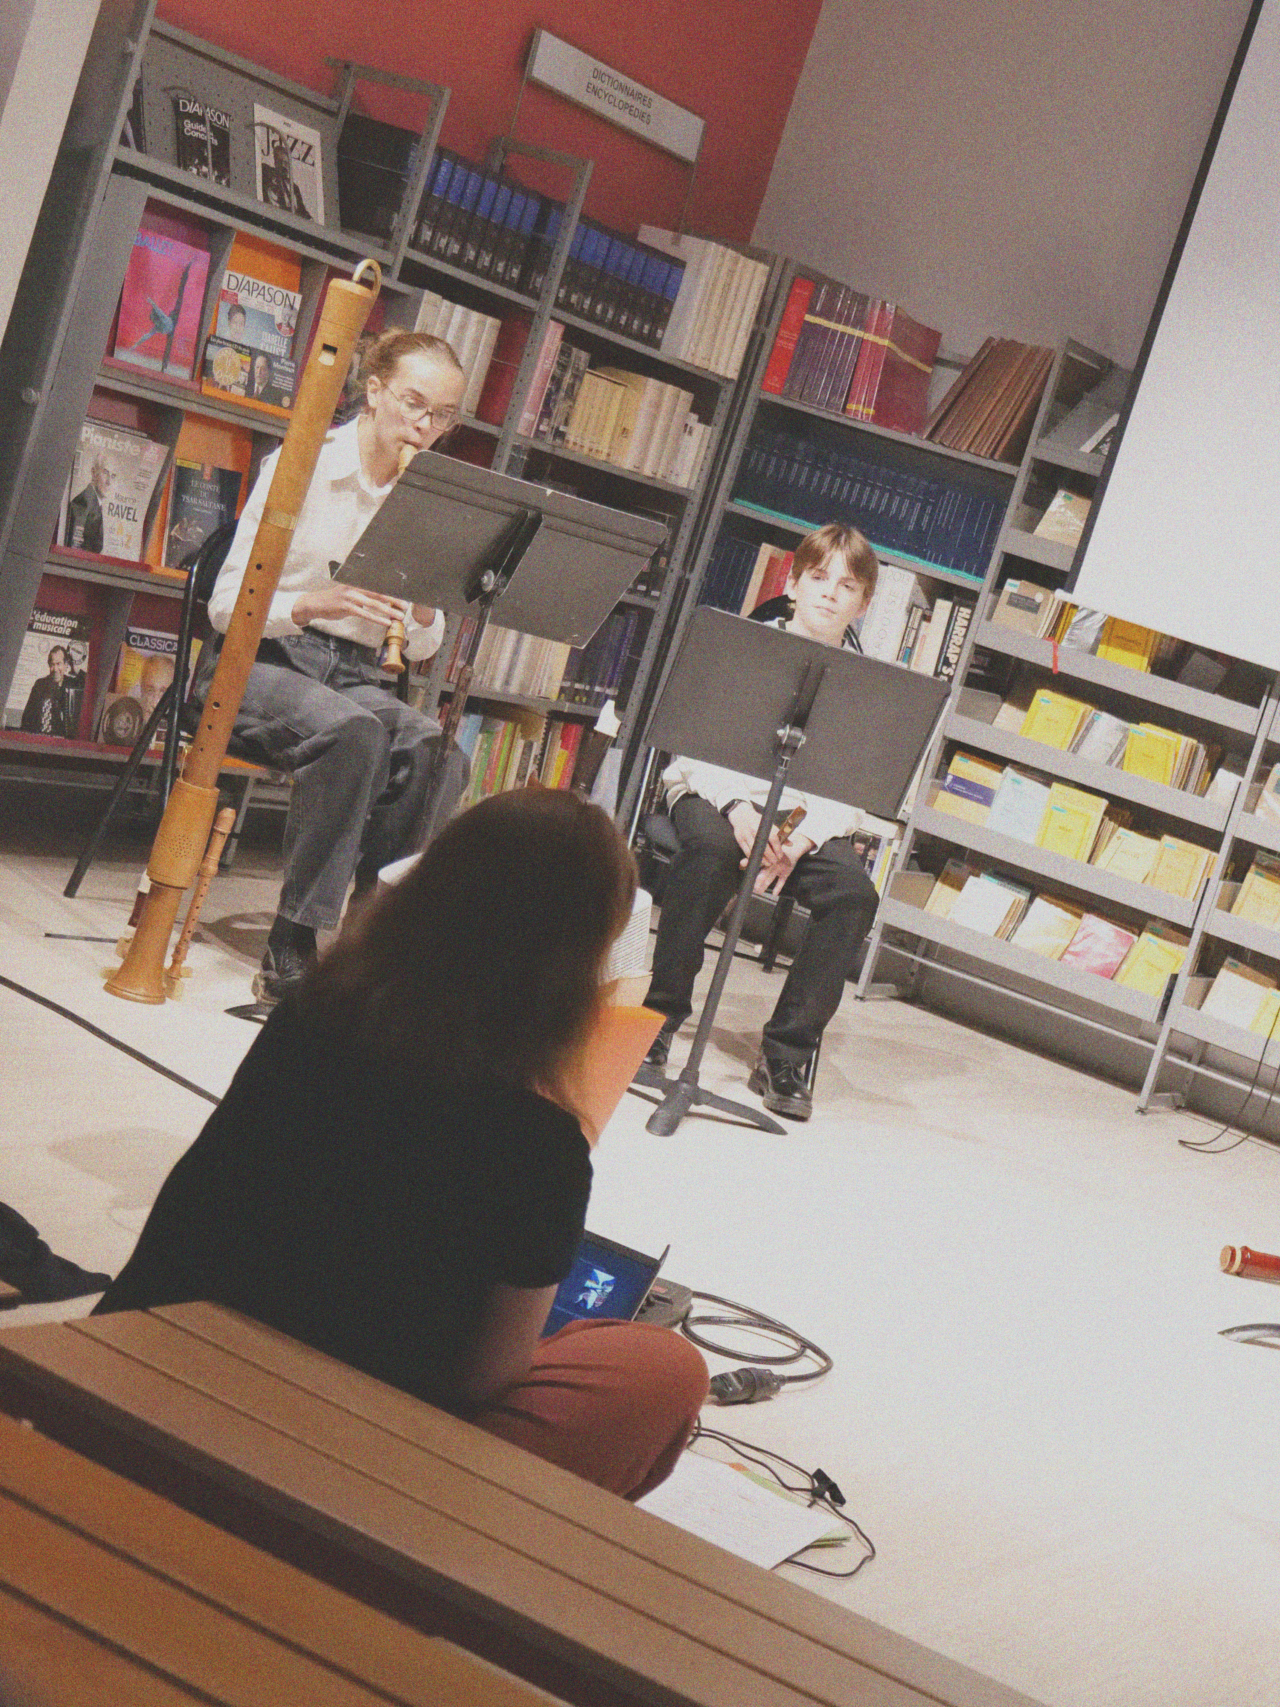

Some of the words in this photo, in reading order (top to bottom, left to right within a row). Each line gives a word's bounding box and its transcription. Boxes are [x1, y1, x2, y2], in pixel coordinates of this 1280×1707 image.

[585, 81, 652, 125] ENCYCLOPEDIES
[592, 67, 653, 109] DICTIONNAIRES
[178, 98, 230, 128] DIAASON
[81, 426, 142, 456] Pianiste
[107, 502, 139, 523] RAVEL
[32, 622, 72, 636] musicale
[941, 606, 972, 676] HARRAP'S
